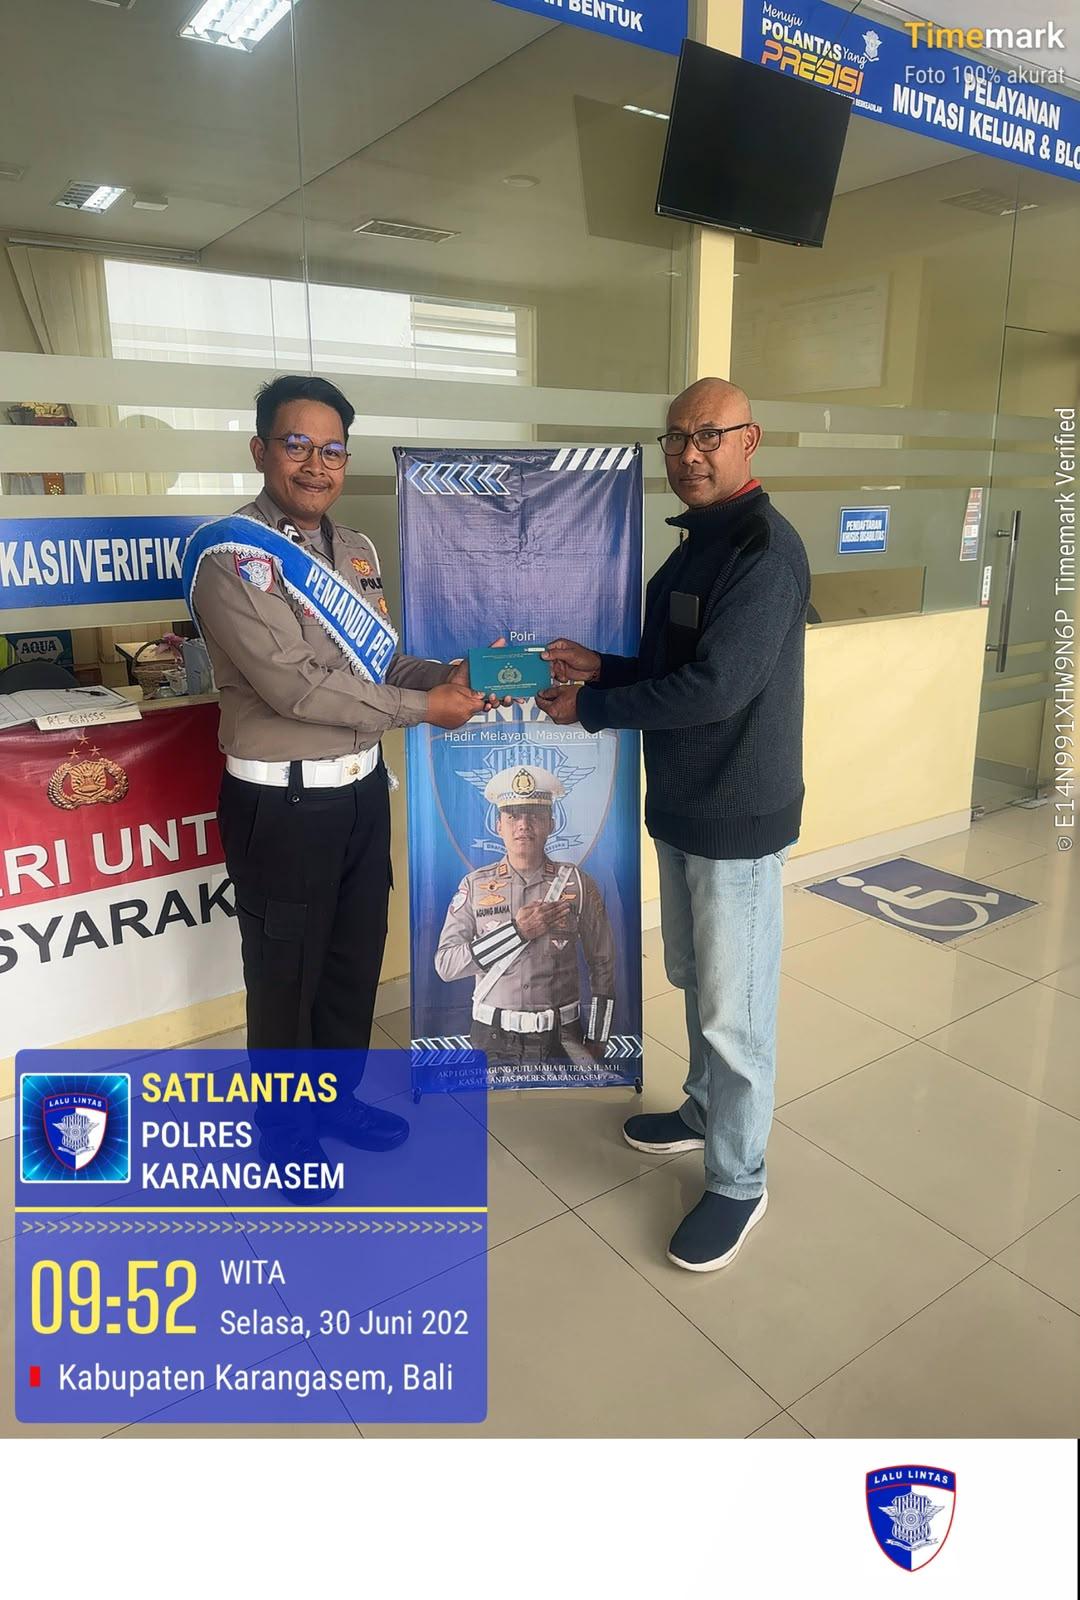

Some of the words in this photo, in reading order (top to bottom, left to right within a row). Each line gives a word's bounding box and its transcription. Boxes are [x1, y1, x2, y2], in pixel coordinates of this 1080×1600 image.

[569, 0, 643, 32] BENTUK
[763, 1, 803, 28] Menuju
[761, 17, 842, 61] POLANTAS
[842, 46, 868, 70] Yang
[760, 39, 864, 95] PRESISI
[892, 83, 964, 133] MUTASI
[969, 110, 1035, 156] KELUAR
[1039, 134, 1051, 161] &
[964, 73, 1061, 131] PELAYANAN
[0, 538, 188, 587] KASI/VERIFIK
[305, 563, 376, 648] PEMANDU
[365, 628, 395, 676] PEL
[510, 631, 536, 642] Polri
[21, 640, 57, 655] AQUA
[444, 731, 477, 742] Hadir
[480, 731, 532, 744] Melayani
[537, 730, 604, 742] Masyarakat
[0, 840, 71, 897] RI
[513, 1064, 533, 1074] PUTU
[534, 1064, 558, 1073] MAHA
[516, 1073, 546, 1082] POLRES
[547, 1073, 601, 1082] KARANGASEM
